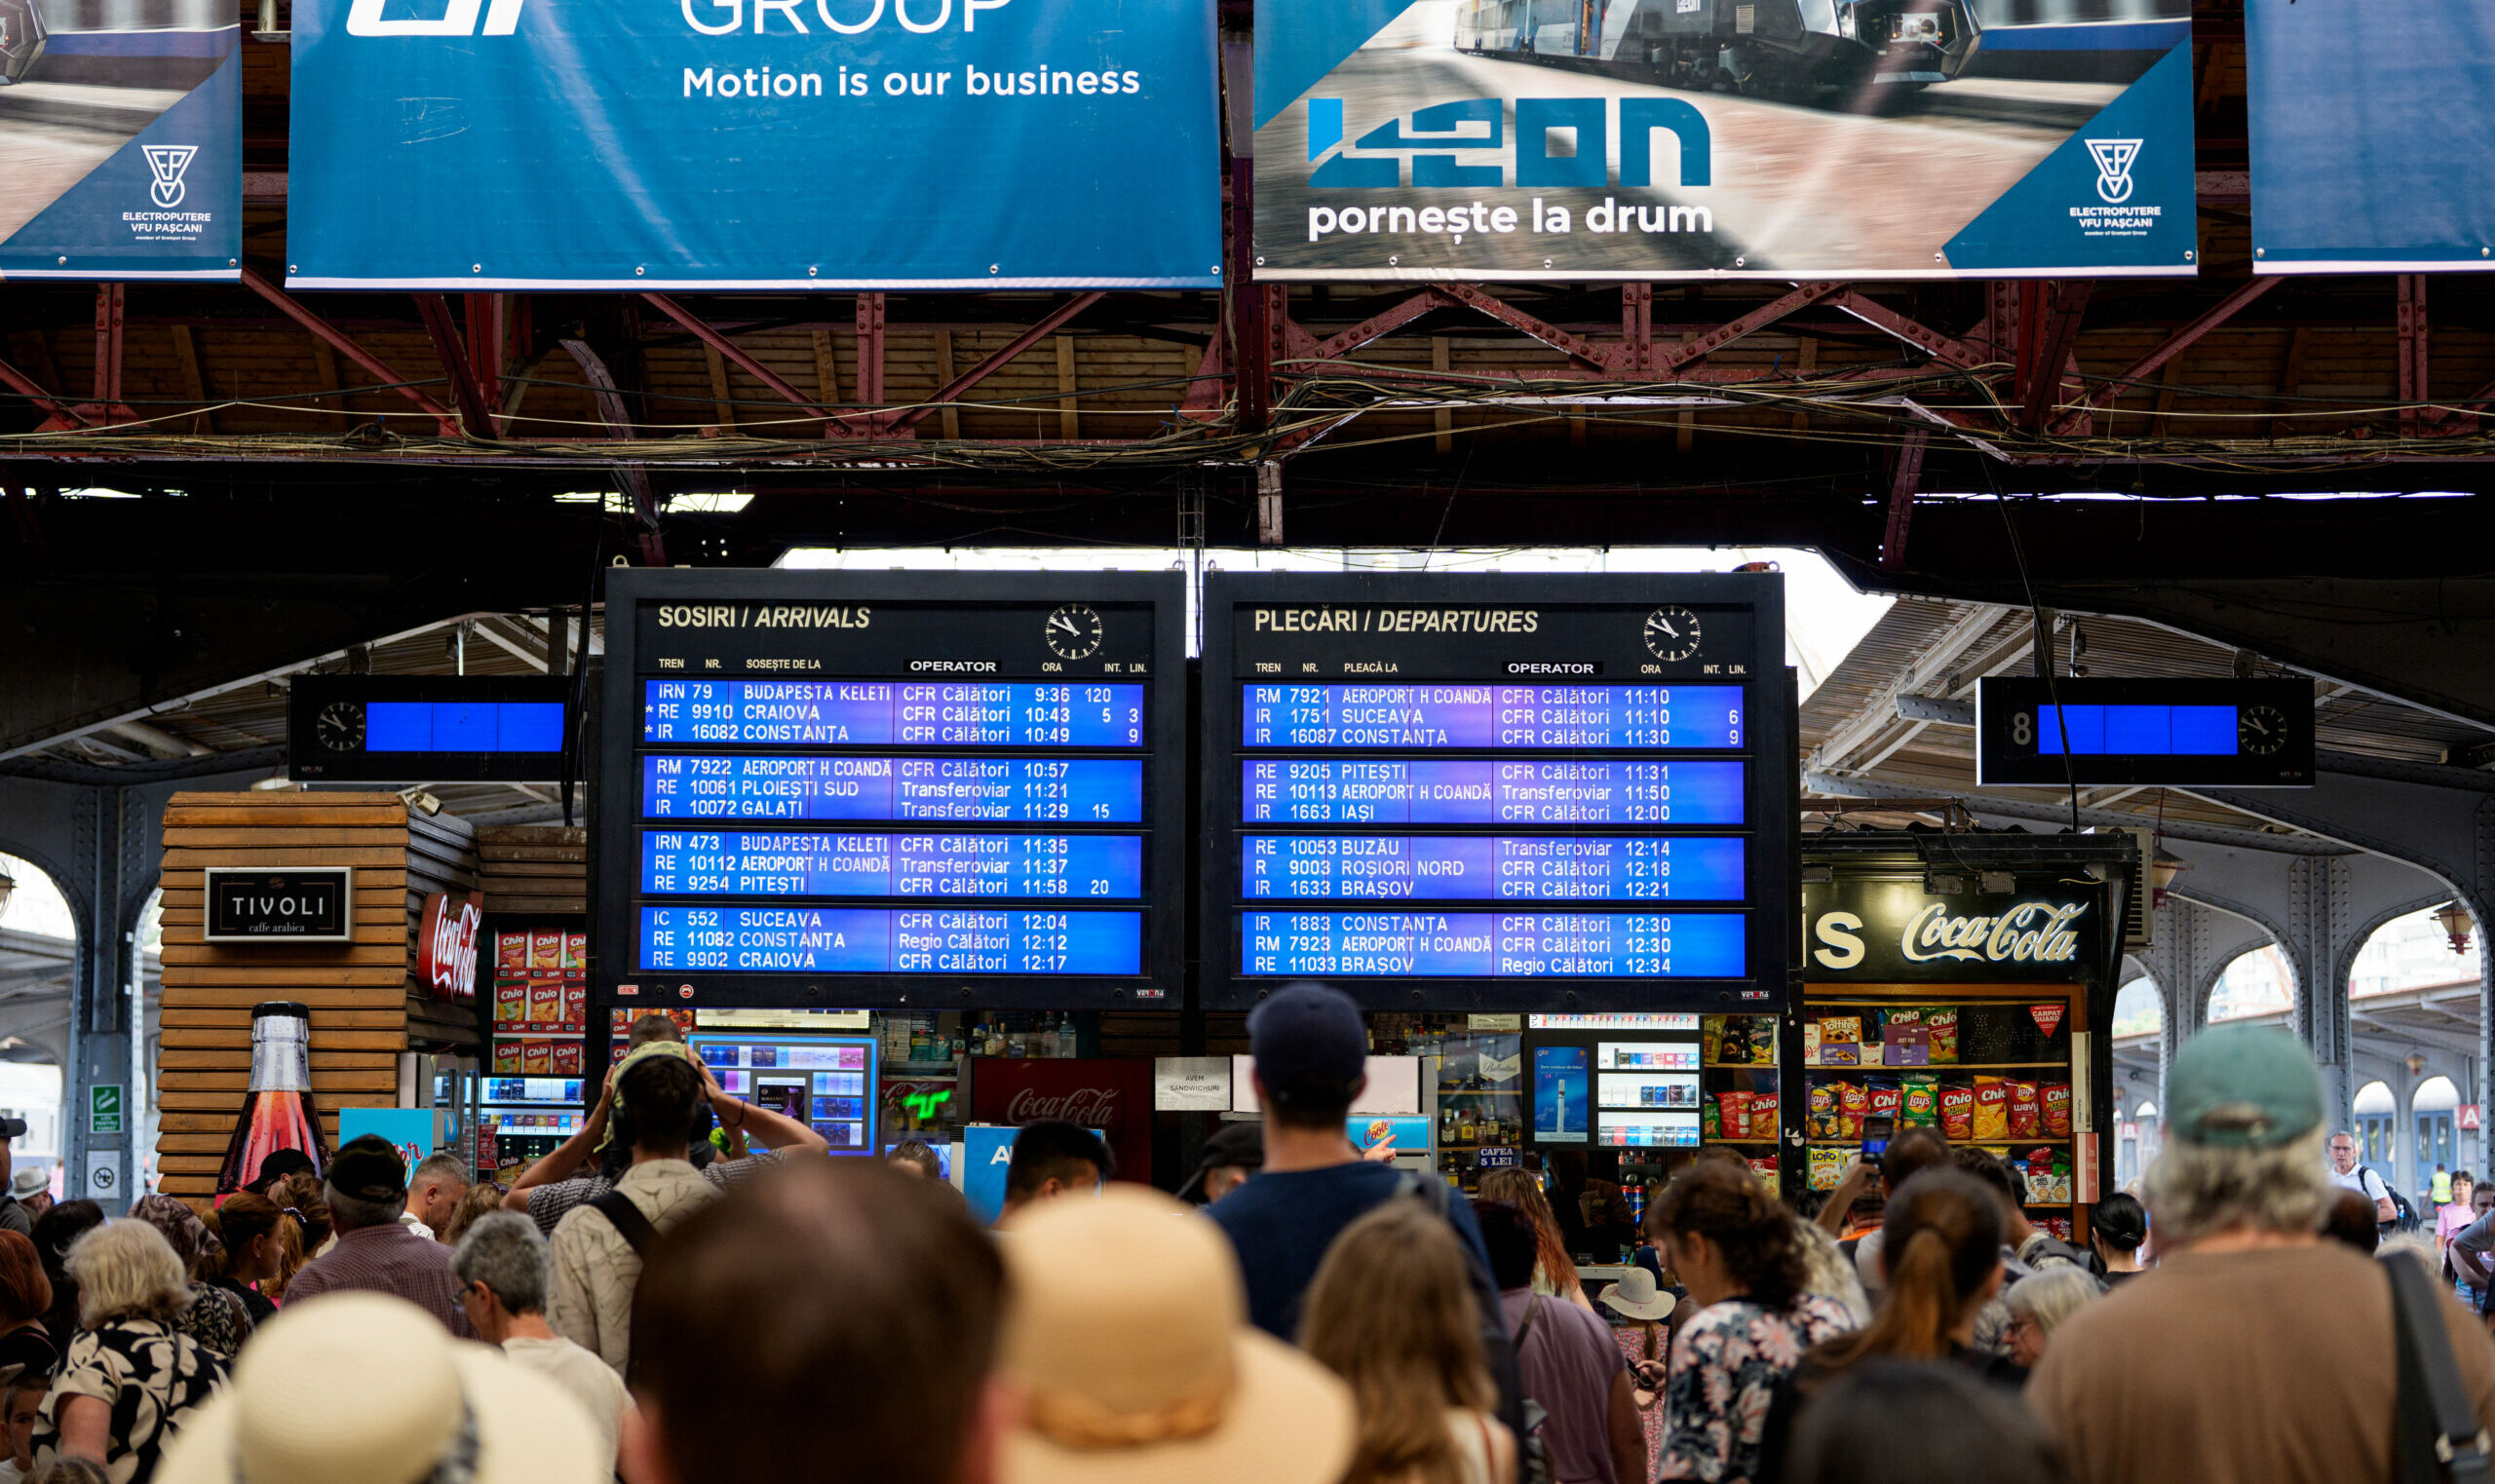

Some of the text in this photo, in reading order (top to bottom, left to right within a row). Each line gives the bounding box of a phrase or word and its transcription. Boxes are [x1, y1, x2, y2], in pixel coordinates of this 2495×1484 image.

[683, 64, 1140, 97] Motion is our business
[122, 211, 211, 222] ELECTROPUTERE
[2069, 206, 2162, 216] ELECTROPUTERE
[131, 223, 153, 233] VFU
[1308, 197, 1713, 245] pornește la drum
[2078, 218, 2101, 228] VFU
[658, 606, 736, 628] SOSIRI
[753, 606, 871, 628] ARRIVALS
[1254, 606, 1358, 632] PLECĂRI
[1377, 610, 1539, 633] DEPARTURES
[658, 658, 685, 668] TREN
[705, 658, 722, 669] NR.
[792, 659, 807, 669] DE
[807, 659, 822, 669] LA
[909, 660, 997, 672] OPERATOR
[1041, 662, 1063, 672] ORA
[1104, 663, 1122, 673] INT.
[1129, 663, 1147, 673] LIN.
[1254, 660, 1746, 674] TREN NR. PLEACĂ LA OPERATOR ORA INT. LIN.
[658, 683, 1112, 704] IRN 79 BUDAPESTA KELETI CFR Călători 9:36 120
[658, 702, 1139, 724] RE 9910 CRAIOVA CFR Călători 10:43 5 3
[2013, 711, 2032, 746] 8
[656, 779, 678, 795] RE
[689, 779, 736, 795] 10061
[824, 780, 860, 797] SUD
[902, 781, 1012, 798] Transferoviar
[1023, 781, 1068, 799] 11:21
[1255, 782, 1670, 801] RE 10113 AEROPORT H COANDĂ Transferoviar 11:50
[1255, 803, 1271, 819] IR
[1289, 804, 1331, 821] 1663
[1502, 805, 1535, 820] CFR
[1541, 804, 1610, 820] Călători
[1625, 805, 1670, 821] 12:00
[1255, 837, 1670, 856] RE 10053 BUZĂU Transferoviar 12:14
[654, 855, 1069, 875] RE 10112 AEROPORT H COANDĂ Transferoviar 11:37
[1255, 858, 1267, 876] R
[1288, 858, 1331, 876] 9003
[1417, 860, 1465, 876] NORD
[1502, 860, 1535, 876] CFR
[1542, 859, 1610, 877] Călători
[1625, 860, 1670, 877] 12:18
[231, 896, 325, 916] TIVOLI
[249, 921, 305, 933] caffe arabica
[1901, 901, 2090, 963] Coca-Cola
[502, 934, 525, 946] Chio
[536, 934, 559, 947] Chio
[653, 930, 675, 947] RE
[686, 931, 735, 947] 11082
[899, 932, 942, 952] Regio
[947, 932, 1011, 950] Călători
[1021, 933, 1068, 951] 12:12
[1254, 955, 1277, 972] RE
[1288, 956, 1337, 972] 11033
[1502, 957, 1546, 976] Regio
[1550, 956, 1614, 973] Călători
[1626, 957, 1671, 974] 12:34
[500, 989, 523, 1001] Chio
[534, 989, 557, 1001] Chio
[1891, 1010, 1920, 1025] Chio
[1930, 1011, 1957, 1027] Chio
[498, 1046, 519, 1057] Chio
[527, 1046, 549, 1057] Chio
[557, 1046, 577, 1057] Chio
[1943, 1092, 1973, 1107] Chio
[2013, 1101, 2040, 1113] wavy
[2463, 1107, 2479, 1125] A
[1479, 1148, 1515, 1157] CAFEA
[1480, 1157, 1514, 1166] 5 LEI
